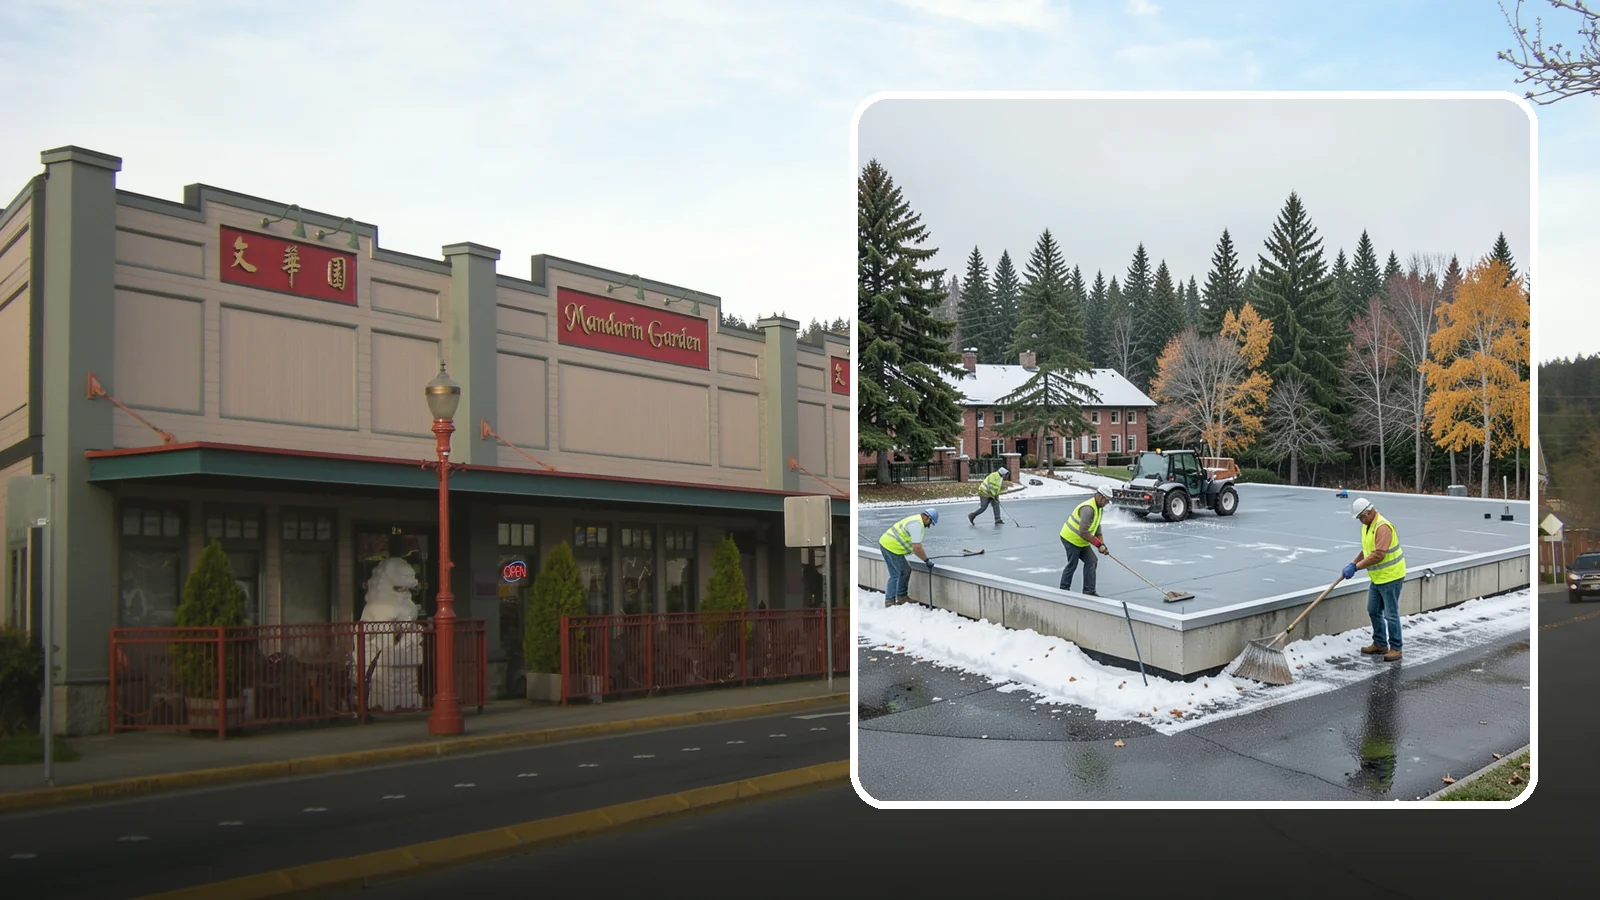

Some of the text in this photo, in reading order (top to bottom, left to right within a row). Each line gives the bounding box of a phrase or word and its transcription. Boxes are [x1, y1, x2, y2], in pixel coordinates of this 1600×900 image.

[231, 236, 346, 290] 文華園
[565, 303, 701, 351] Mandarin Garden
[503, 565, 527, 578] OPEN
